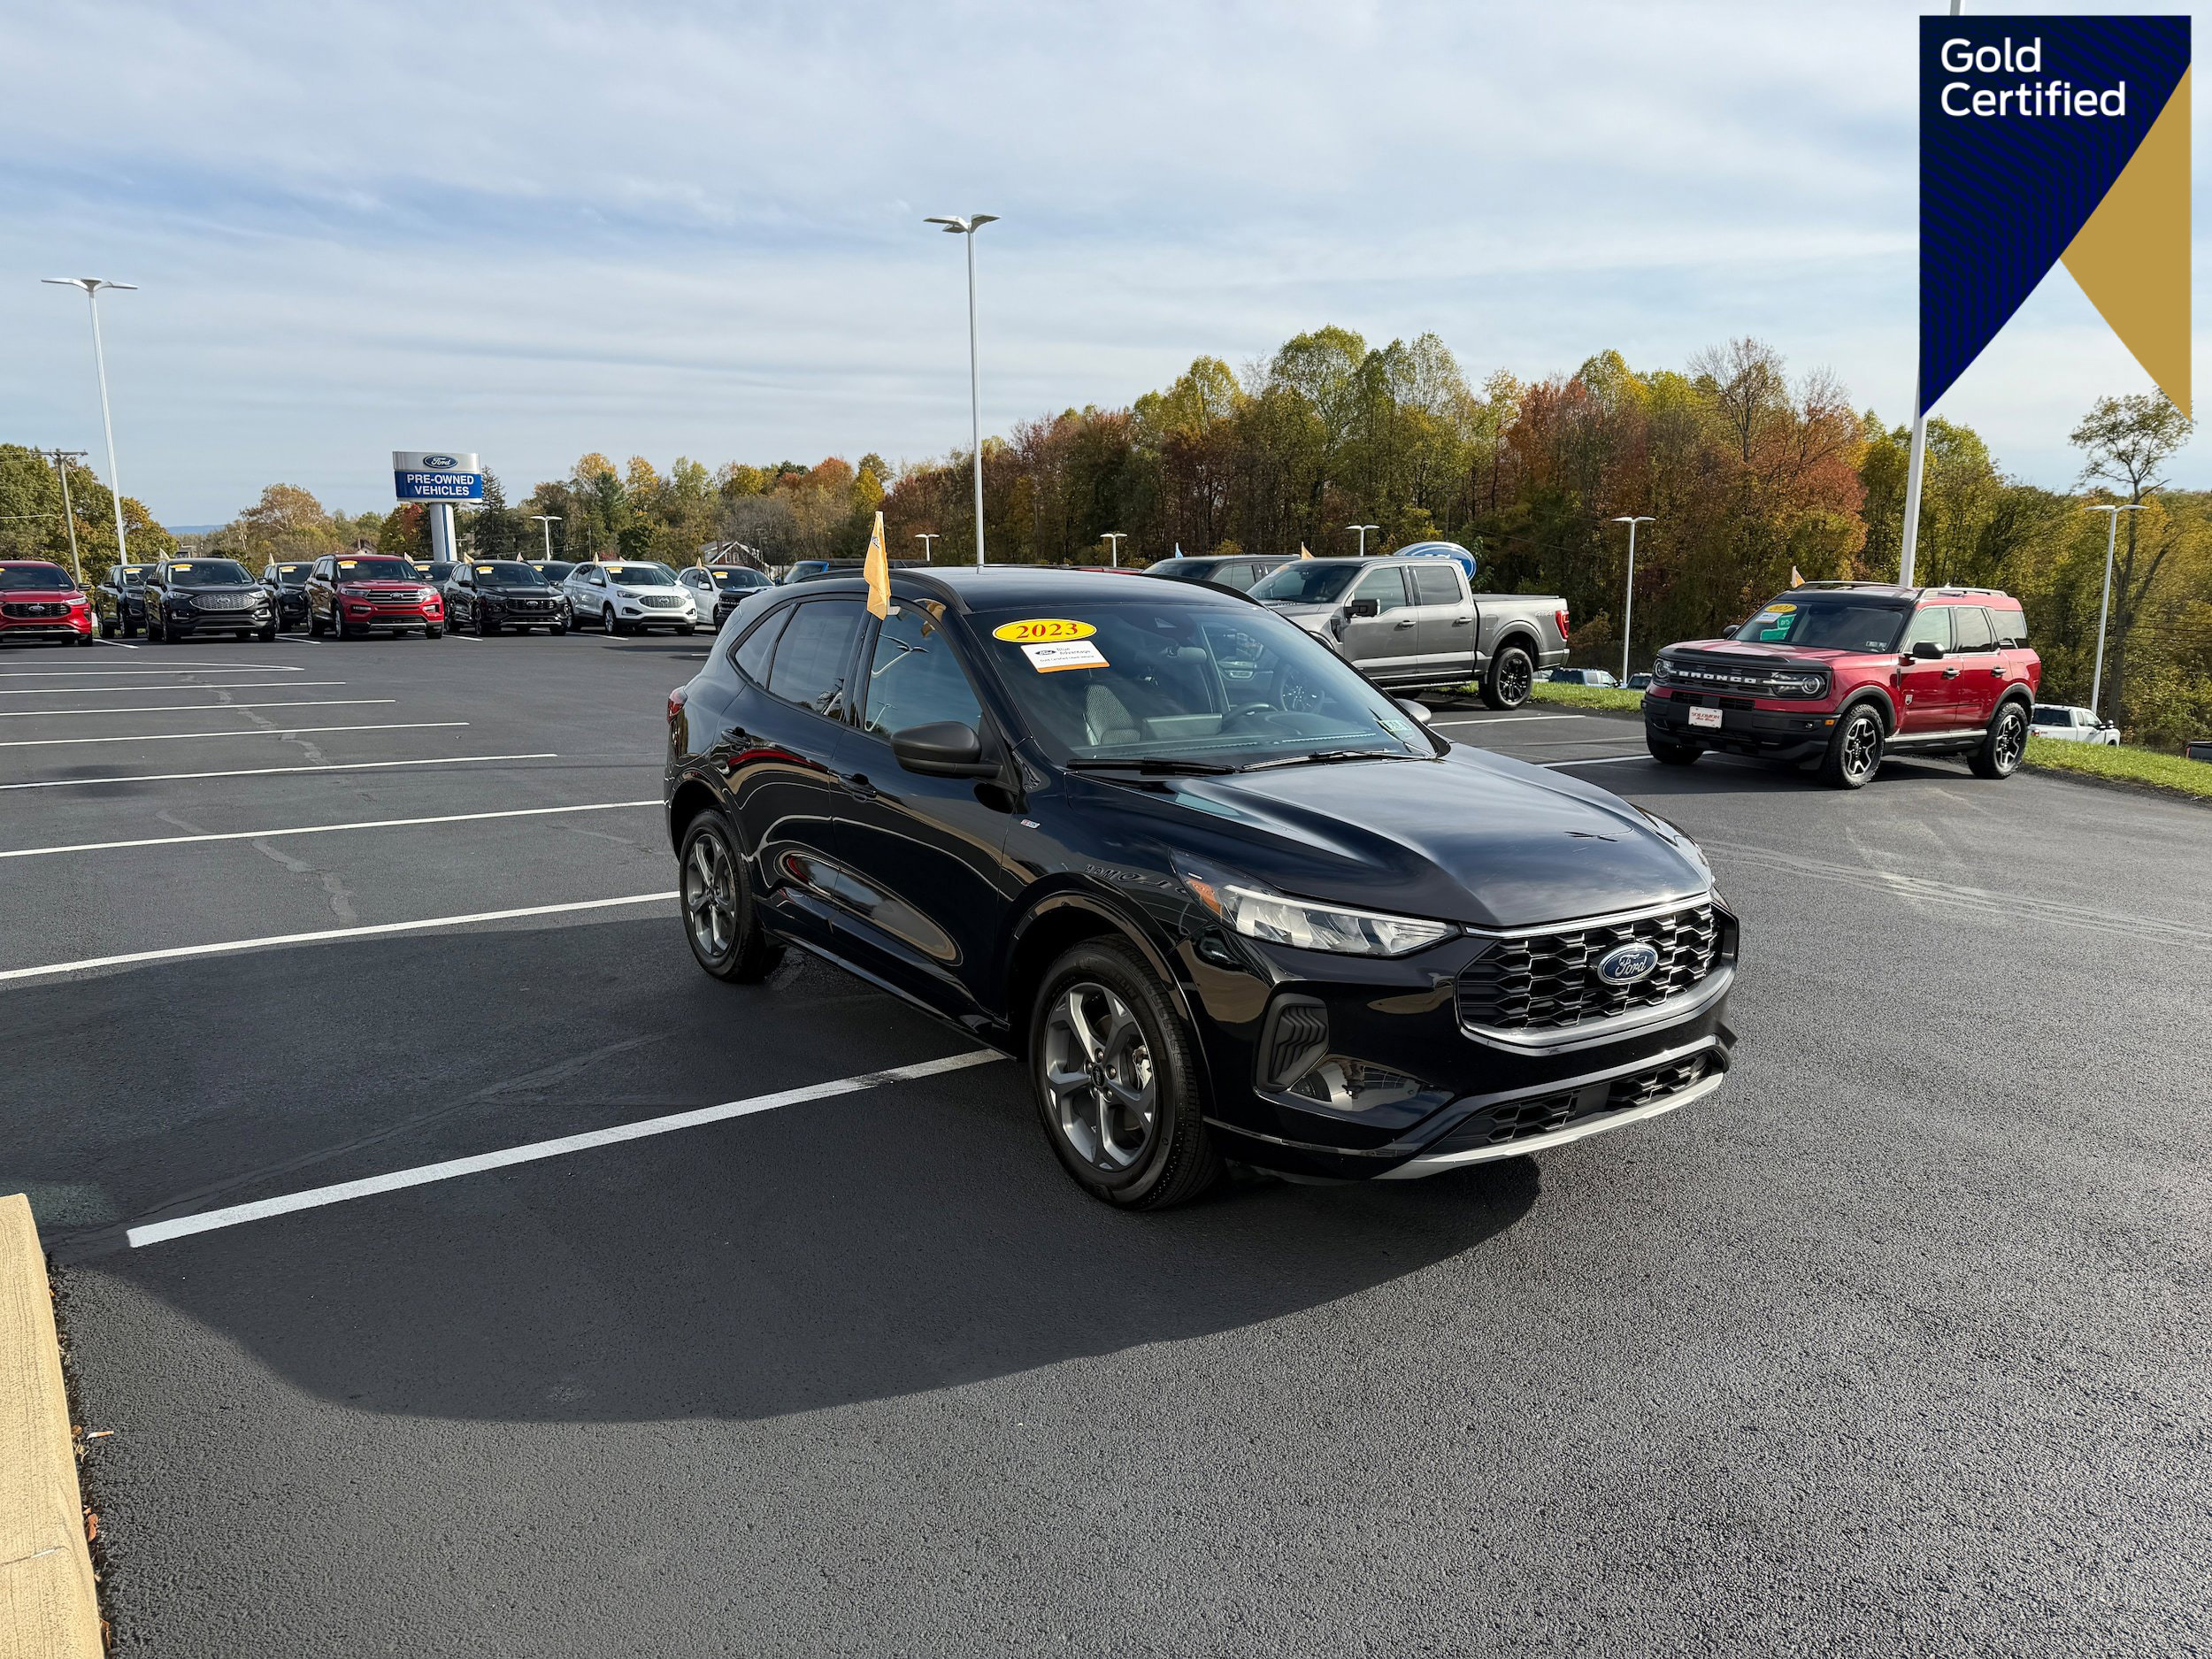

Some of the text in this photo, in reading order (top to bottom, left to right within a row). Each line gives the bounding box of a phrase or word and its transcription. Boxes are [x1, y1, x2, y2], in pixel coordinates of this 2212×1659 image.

[406, 473, 474, 485] PRE-OWNED
[414, 485, 470, 496] VEHICLES
[1016, 622, 1079, 639] 2023
[1678, 671, 1757, 684] BRONCO
[1615, 953, 1647, 977] Ford
